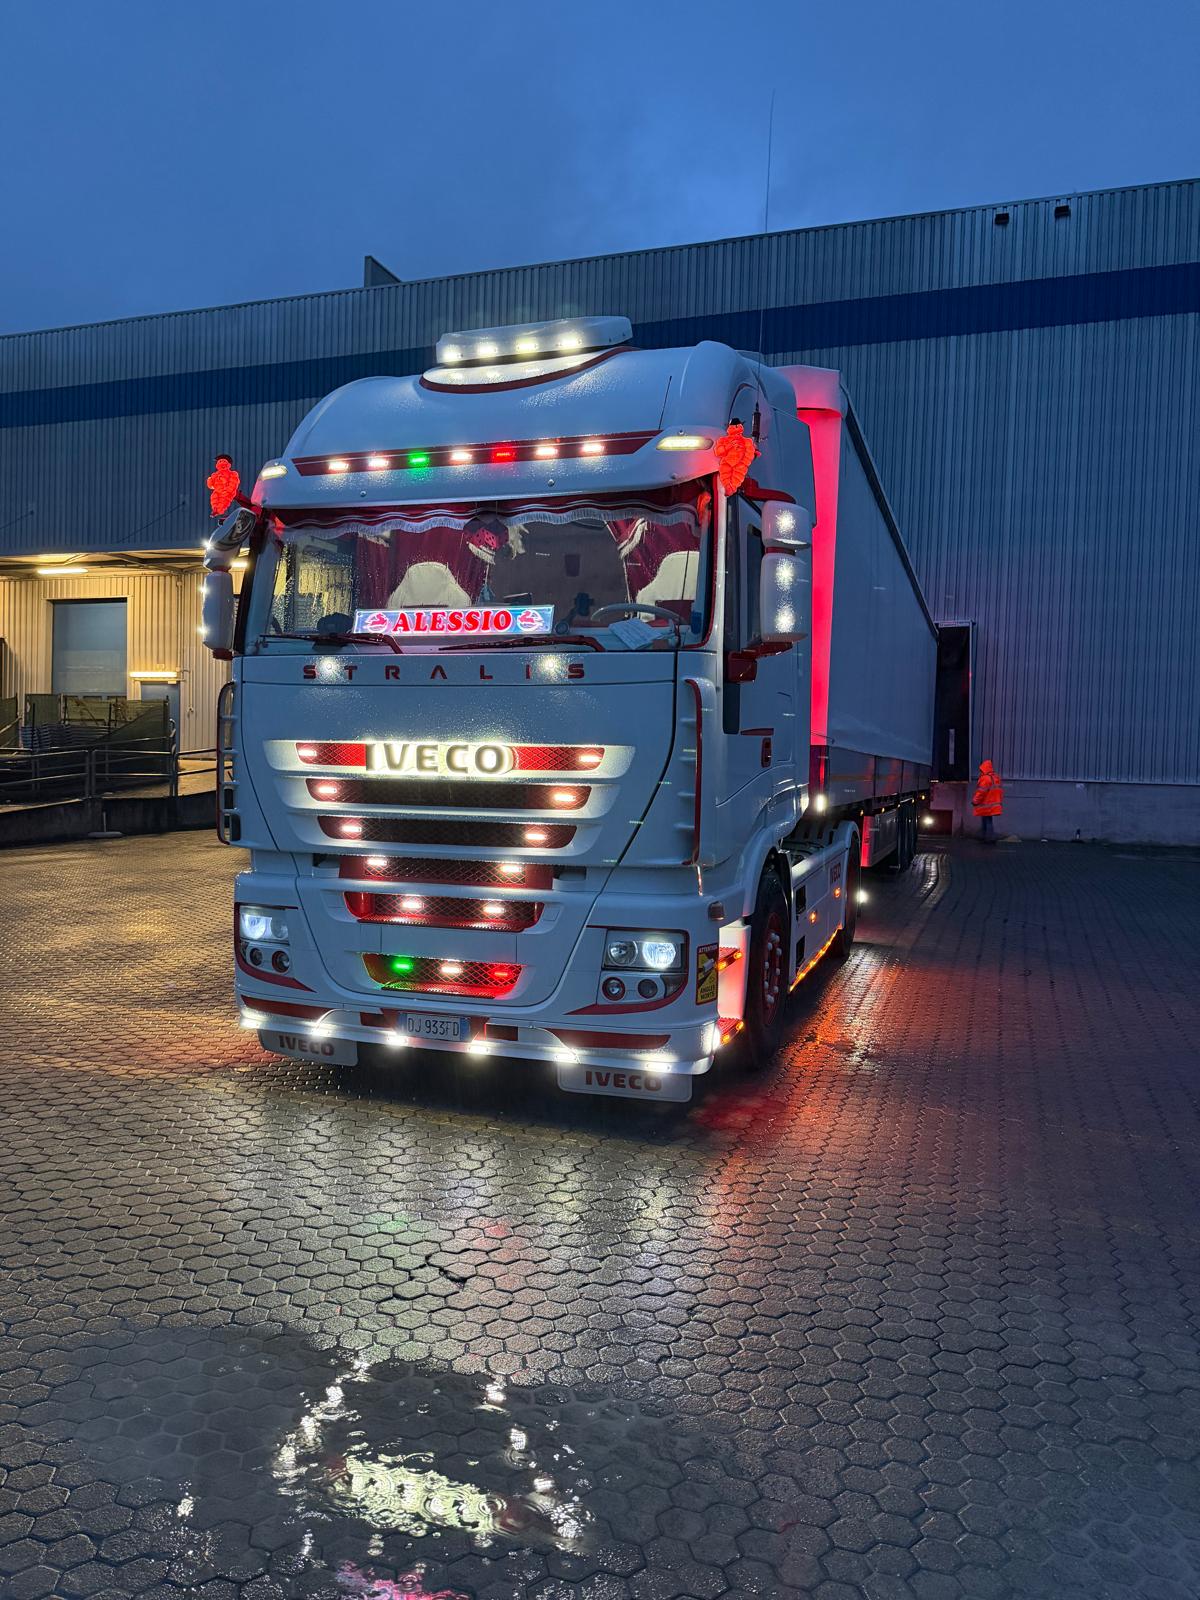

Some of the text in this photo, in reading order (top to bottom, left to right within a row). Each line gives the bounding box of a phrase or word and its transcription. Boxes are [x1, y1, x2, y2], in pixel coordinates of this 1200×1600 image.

[393, 610, 512, 632] ALESSIO
[303, 663, 585, 680] STRALIS
[365, 743, 509, 774] IVECO
[279, 1035, 335, 1056] IVECO
[585, 1070, 662, 1092] IVECO
